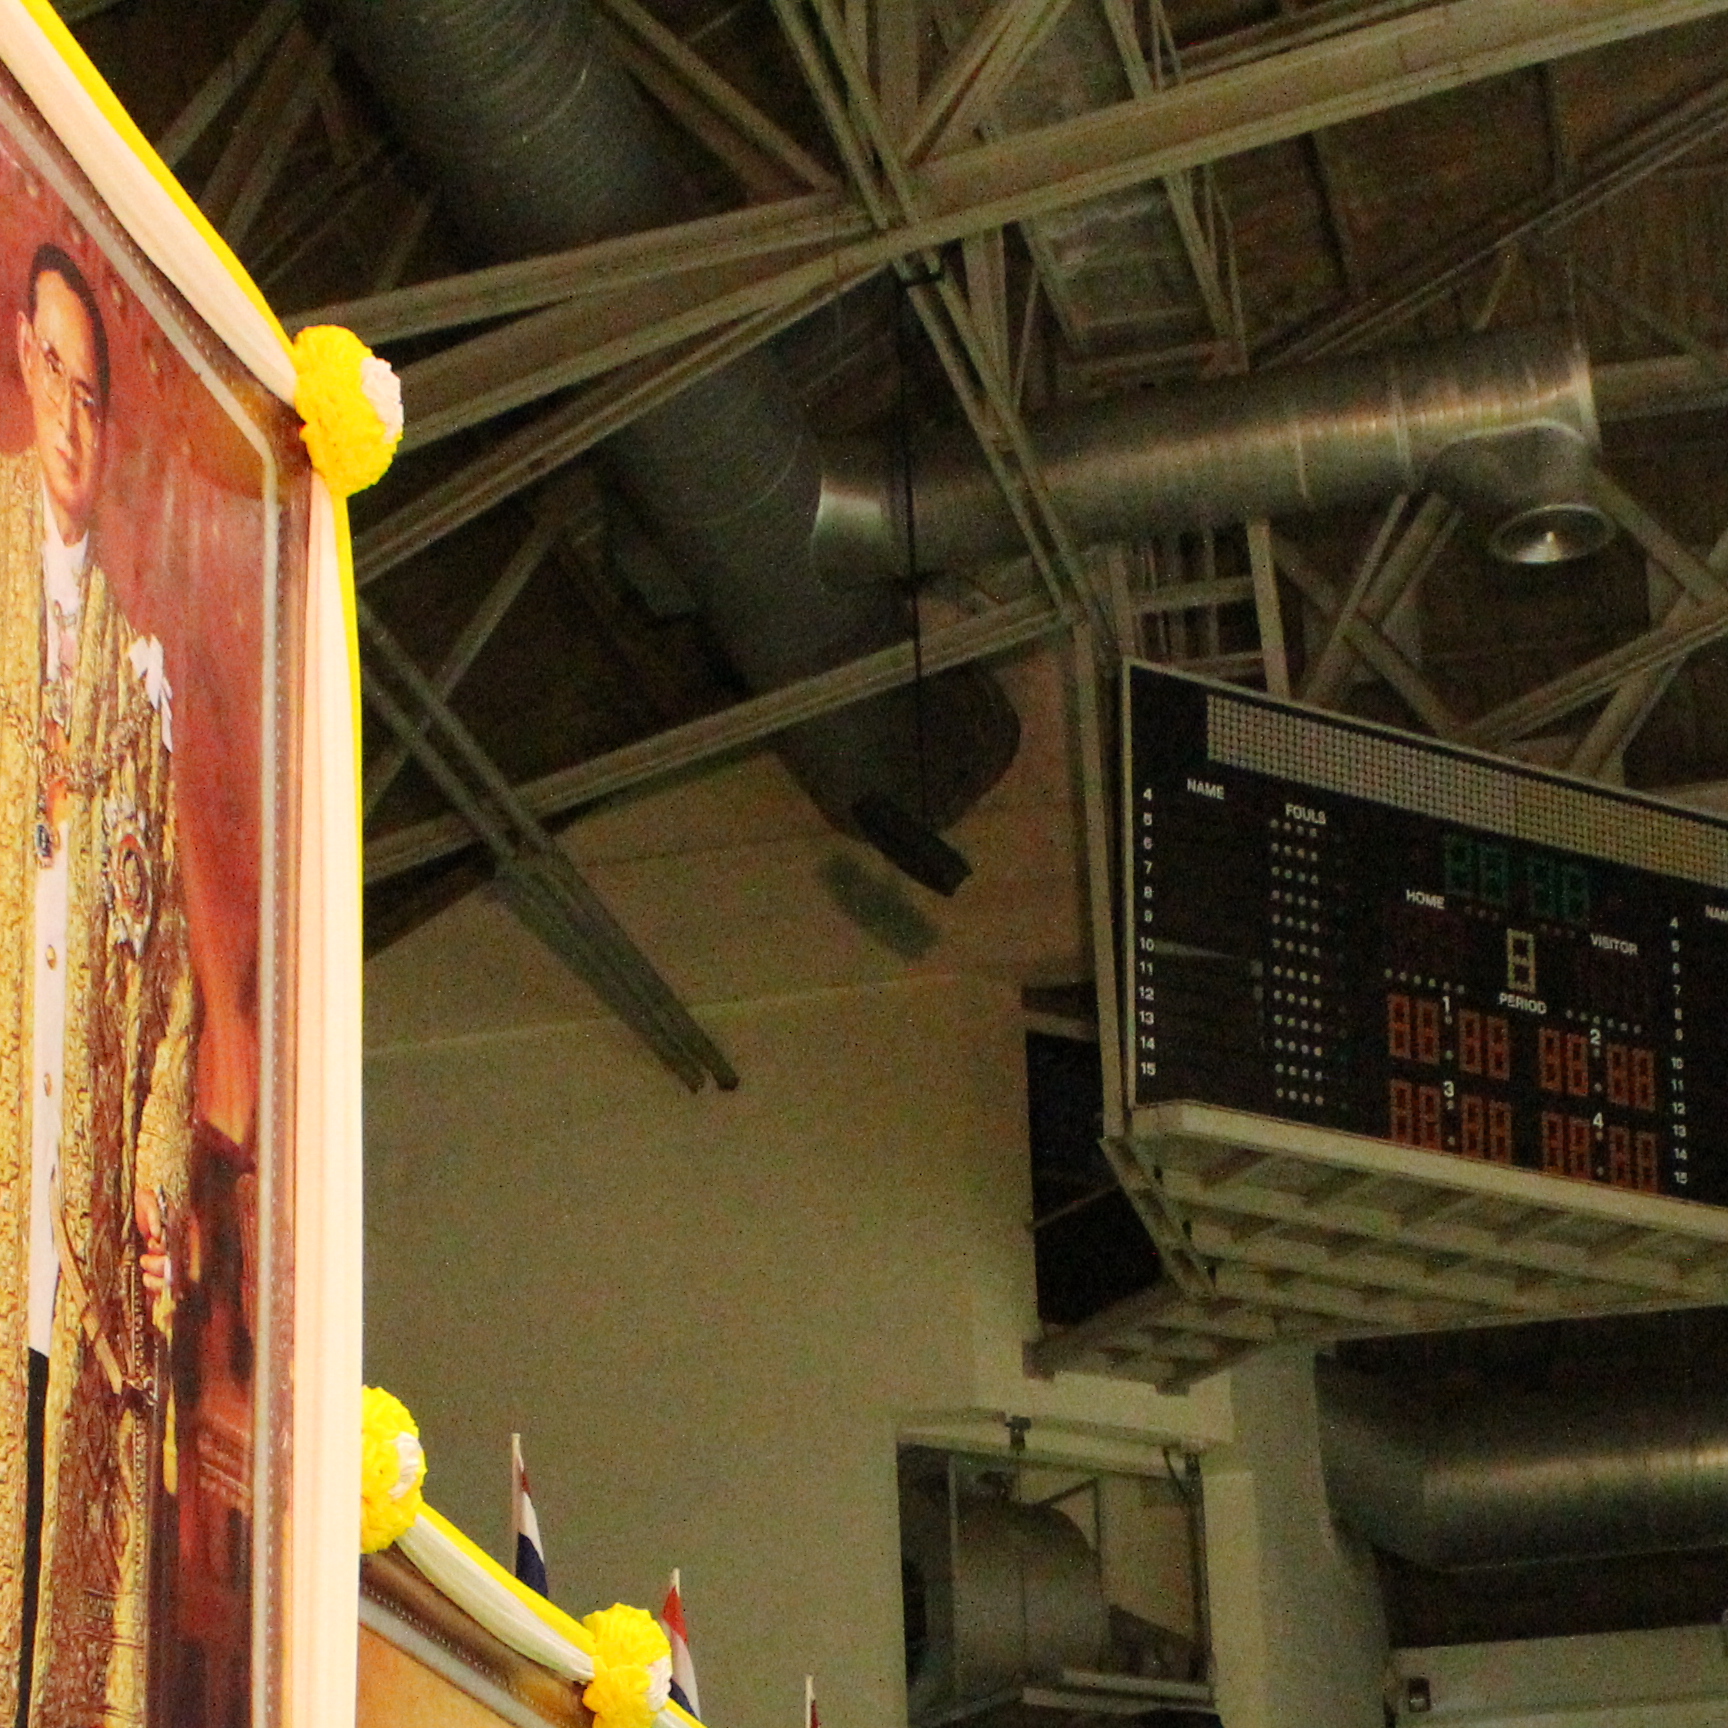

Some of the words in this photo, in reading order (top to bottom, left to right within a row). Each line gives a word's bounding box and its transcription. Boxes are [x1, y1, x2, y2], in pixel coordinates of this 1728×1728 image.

[1143, 787, 1152, 801] 4
[1186, 778, 1225, 800] NAME
[1285, 802, 1327, 825] FOULS
[1144, 862, 1152, 874] 7
[1406, 888, 1445, 910] HOME
[1670, 917, 1679, 929] 4
[1139, 937, 1154, 951] 10
[1590, 932, 1639, 956] VISITOR
[1139, 961, 1154, 975] 11
[1139, 986, 1154, 1000] 12
[1442, 995, 1450, 1014] 1
[1499, 992, 1547, 1015] PERIOD
[1139, 1011, 1154, 1025] 13
[1140, 1036, 1155, 1050] 14
[1590, 1028, 1601, 1046] 2
[1140, 1062, 1156, 1076] 15
[1444, 1080, 1454, 1098] 3
[1672, 1102, 1685, 1116] 12
[1593, 1112, 1603, 1129] 4
